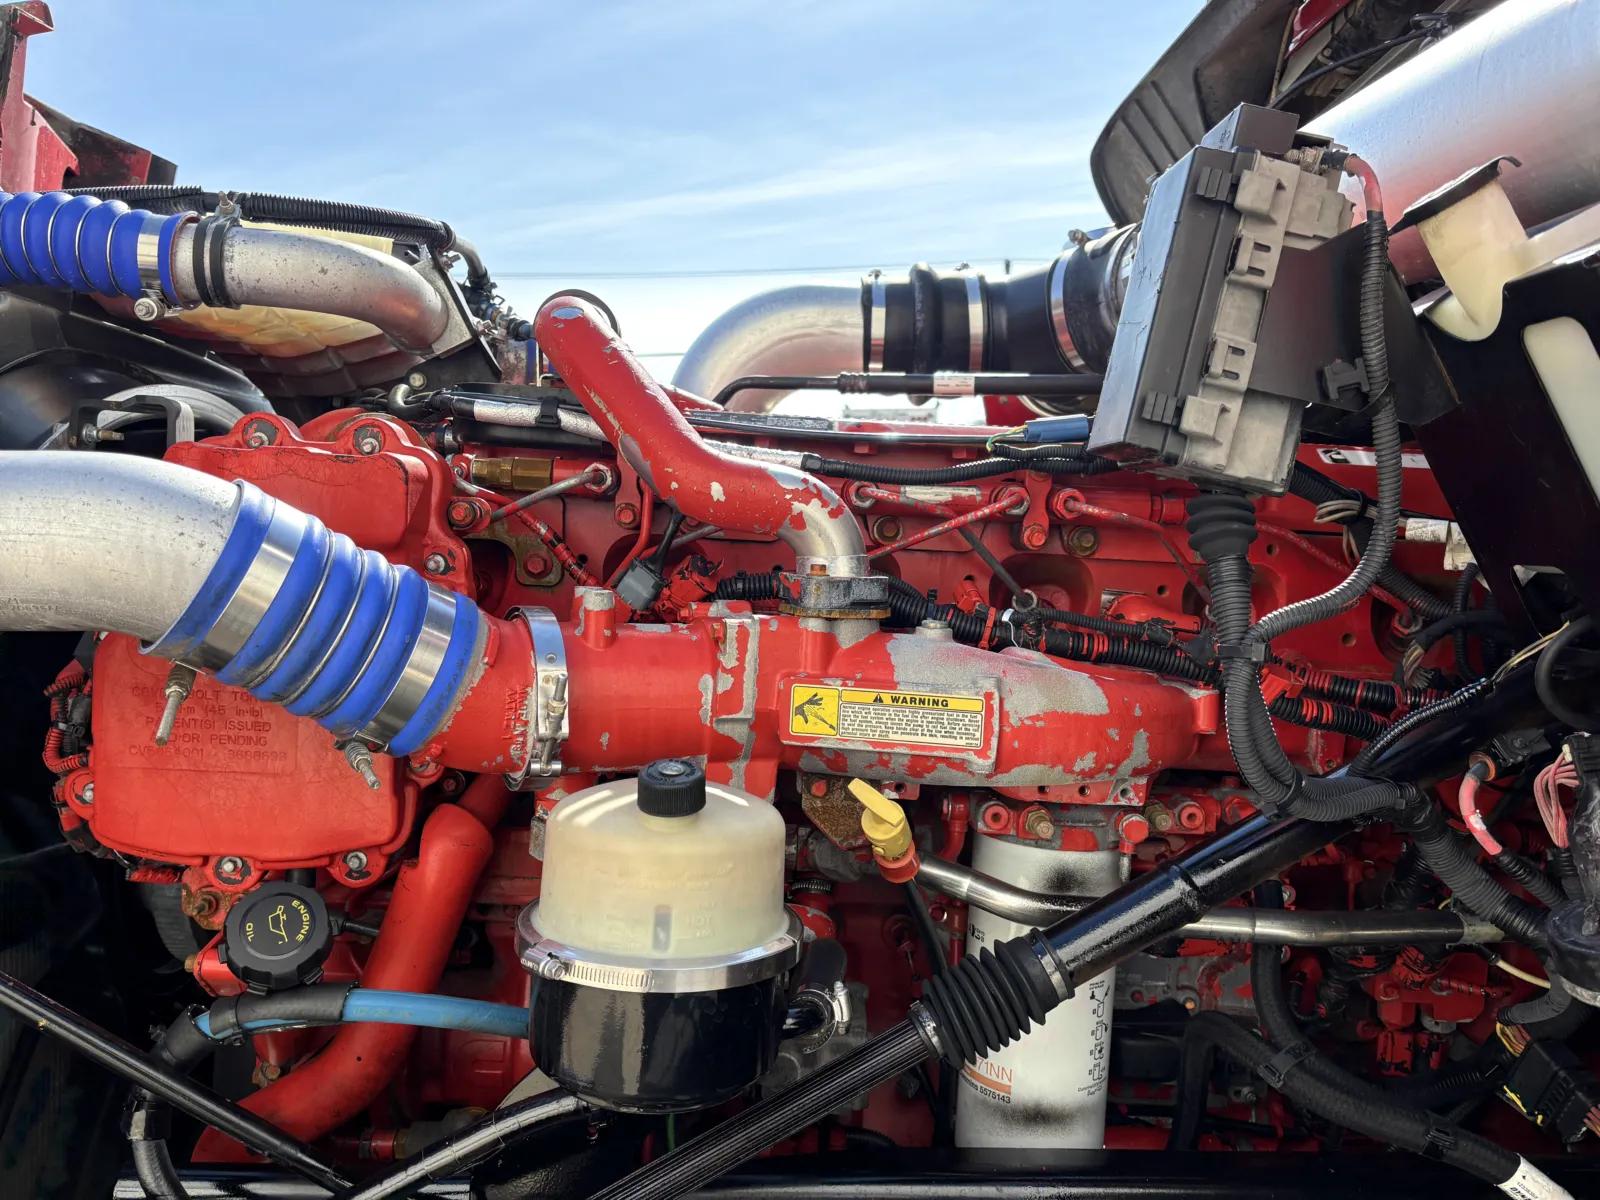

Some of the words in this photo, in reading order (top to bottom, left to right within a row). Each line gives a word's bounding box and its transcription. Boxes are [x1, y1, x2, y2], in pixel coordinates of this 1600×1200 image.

[890, 695, 948, 708] WARNING
[225, 720, 272, 732] ISSUED
[210, 734, 268, 747] PENDING
[292, 900, 310, 943] ENGINE
[246, 922, 254, 942] OIL
